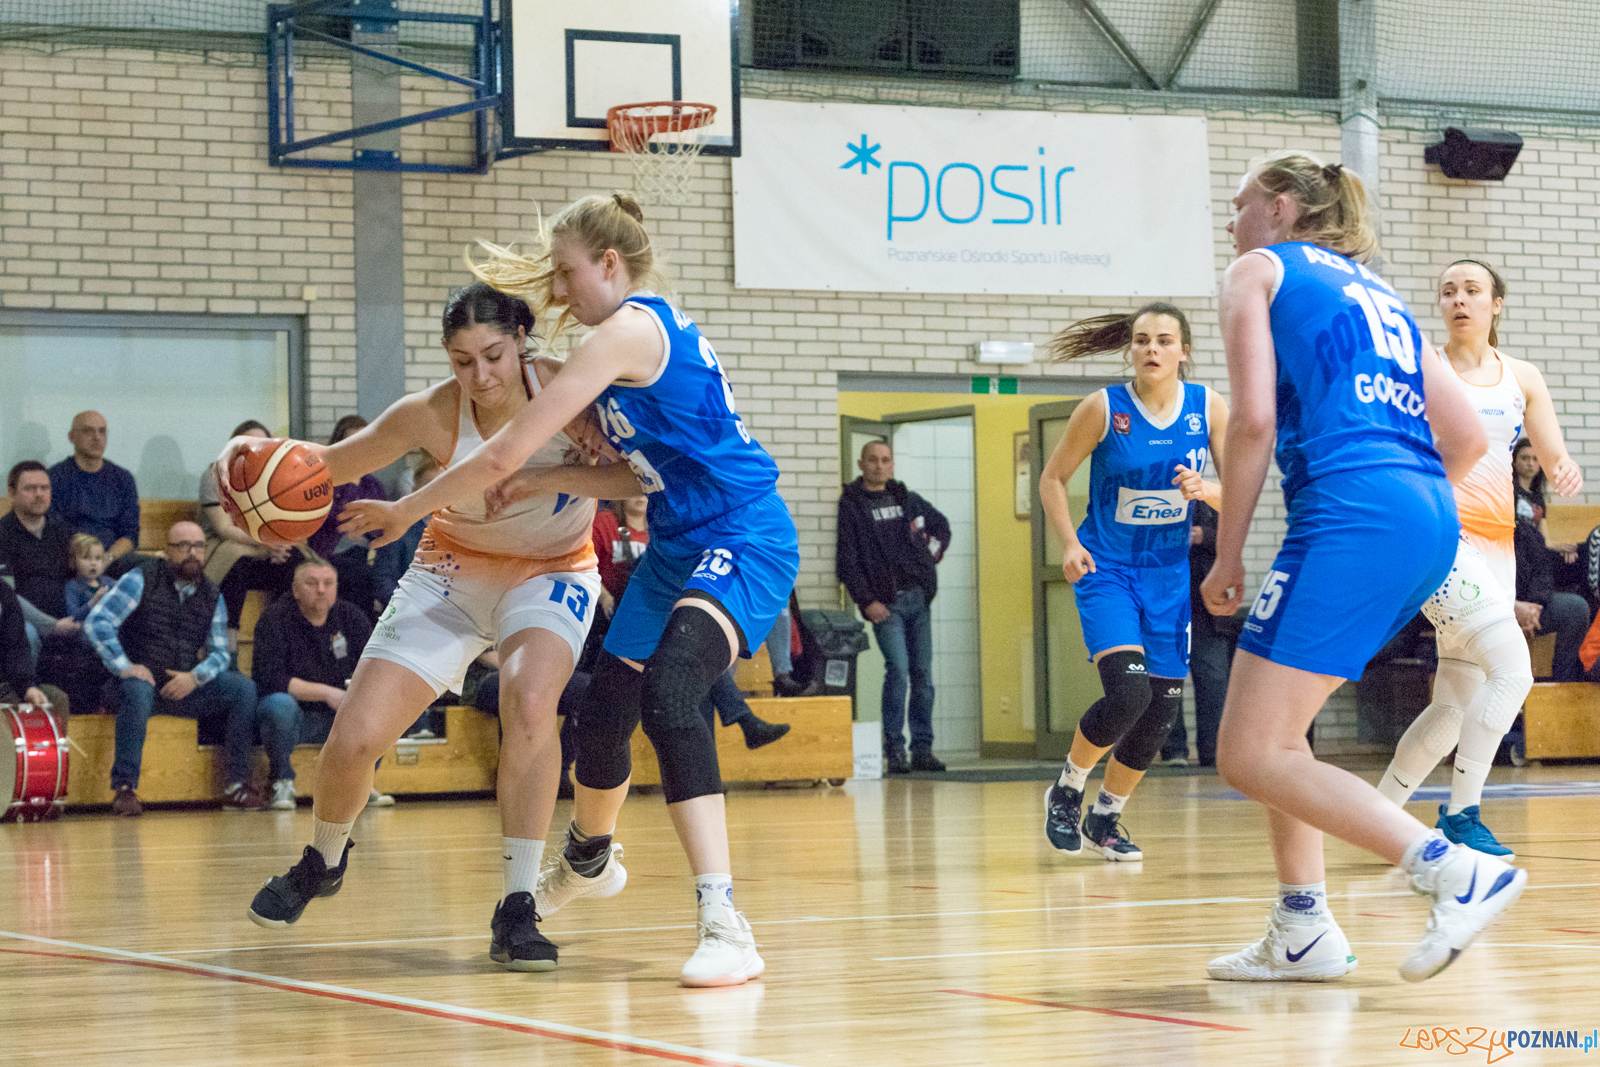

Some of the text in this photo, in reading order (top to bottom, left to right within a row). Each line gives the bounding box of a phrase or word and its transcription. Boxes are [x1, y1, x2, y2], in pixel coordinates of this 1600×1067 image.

[1011, 250, 1051, 267] Sportu
[1301, 245, 1355, 275] AZS
[1342, 282, 1418, 374] 15
[1481, 408, 1505, 417] PROTON
[303, 478, 333, 501] lten
[1132, 505, 1183, 519] Enea
[546, 578, 590, 623] 13
[1249, 570, 1291, 620] 15
